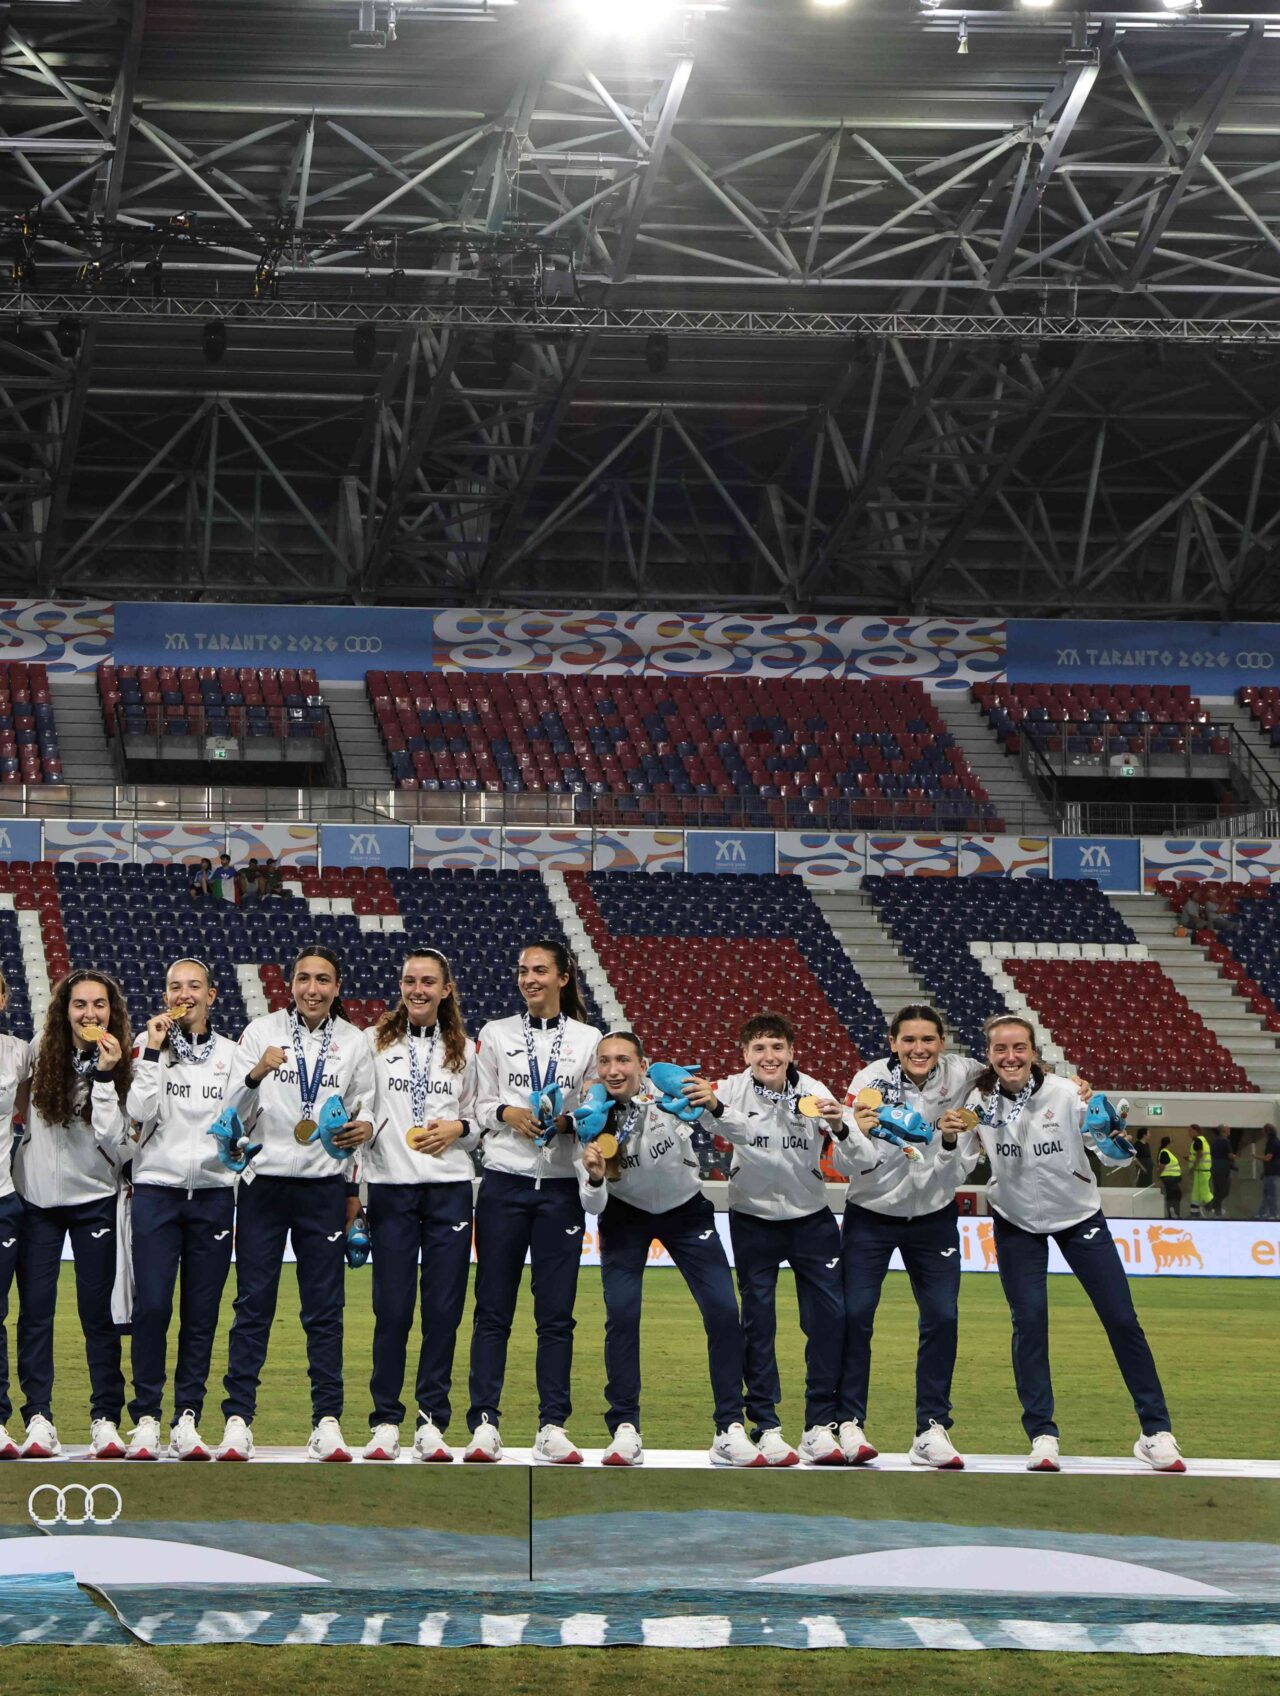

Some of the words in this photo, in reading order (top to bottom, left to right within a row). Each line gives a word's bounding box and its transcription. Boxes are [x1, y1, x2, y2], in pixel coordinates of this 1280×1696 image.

[194, 633, 283, 651] TARANTO
[287, 634, 339, 652] 2026
[1086, 650, 1173, 666] TARANTO
[1178, 651, 1231, 668] 2026
